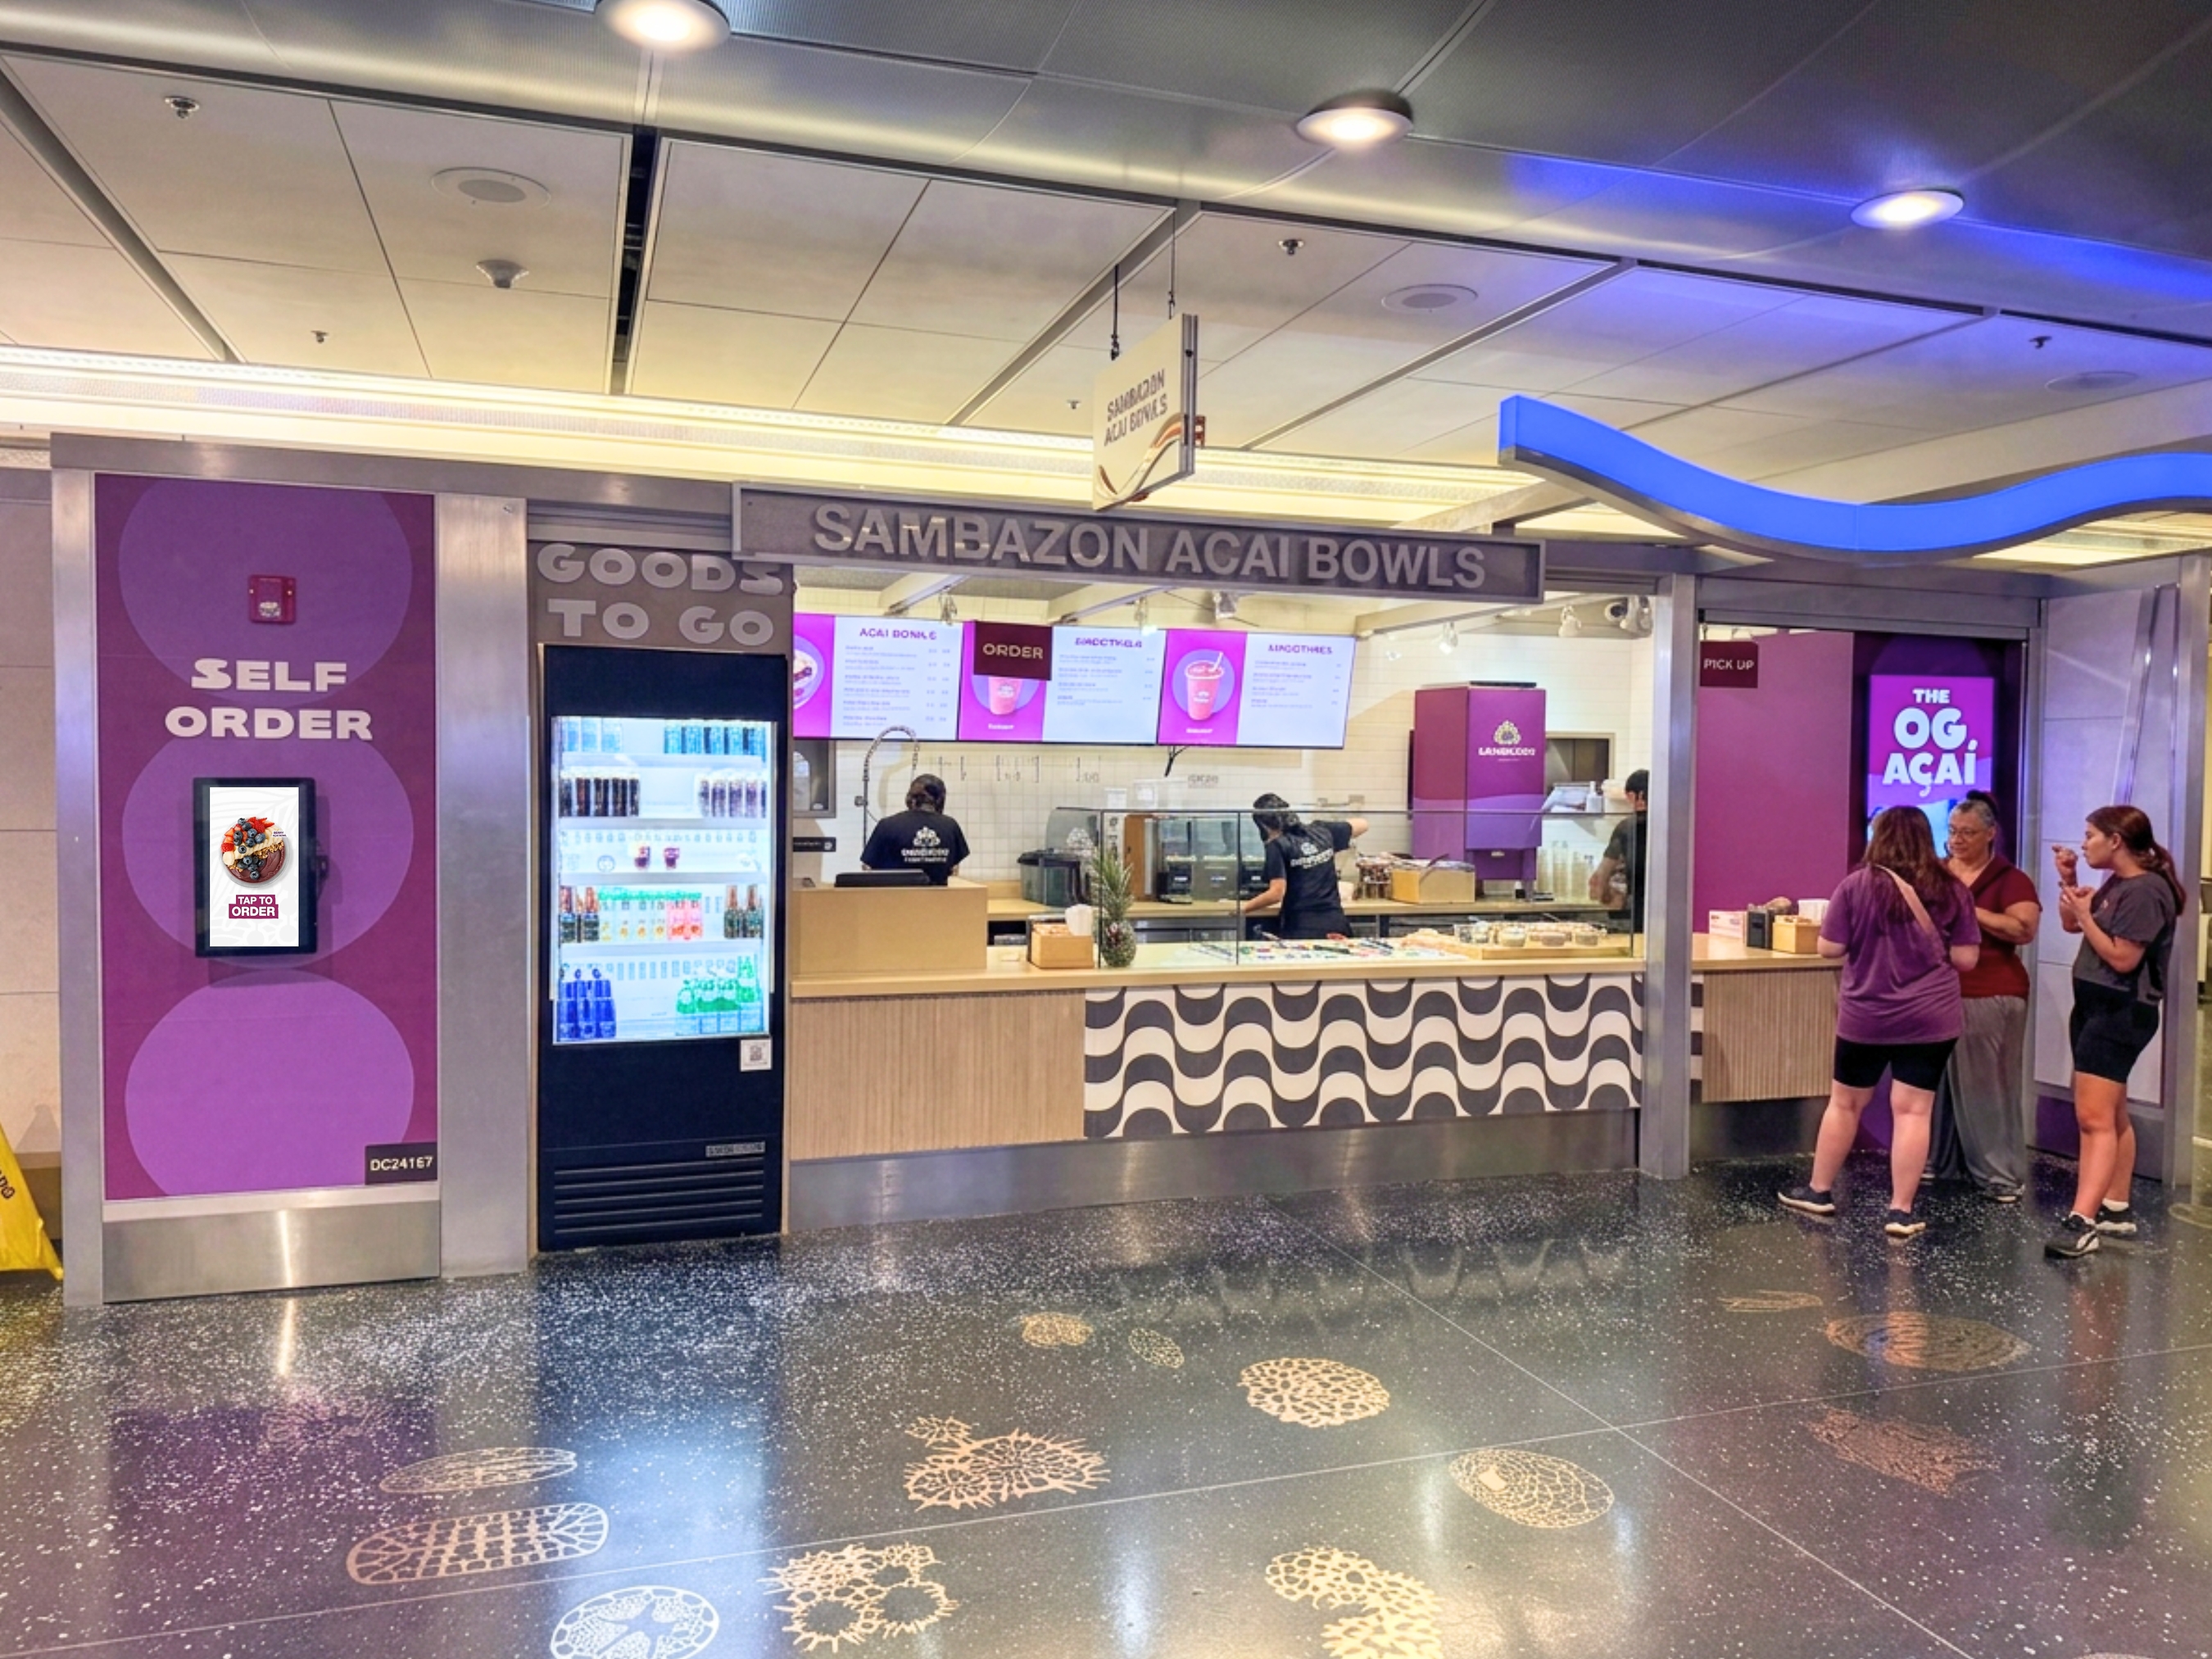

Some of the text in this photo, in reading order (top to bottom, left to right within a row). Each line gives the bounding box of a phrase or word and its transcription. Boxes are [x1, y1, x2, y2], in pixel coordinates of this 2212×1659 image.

[814, 503, 1486, 588] SAMBAZON ACAI BOWLS
[537, 543, 783, 596] GOODS
[547, 598, 773, 646] TO GO
[983, 643, 1044, 660] ORDER
[1704, 658, 1755, 670] PICK UP
[191, 658, 347, 691] SELF
[1912, 688, 1951, 704] THE
[165, 705, 373, 741] ORDER
[1894, 707, 1967, 750] OG
[1883, 739, 1979, 797] AÇAÍ
[231, 906, 275, 917] ORDER
[238, 896, 273, 904] TAP TO
